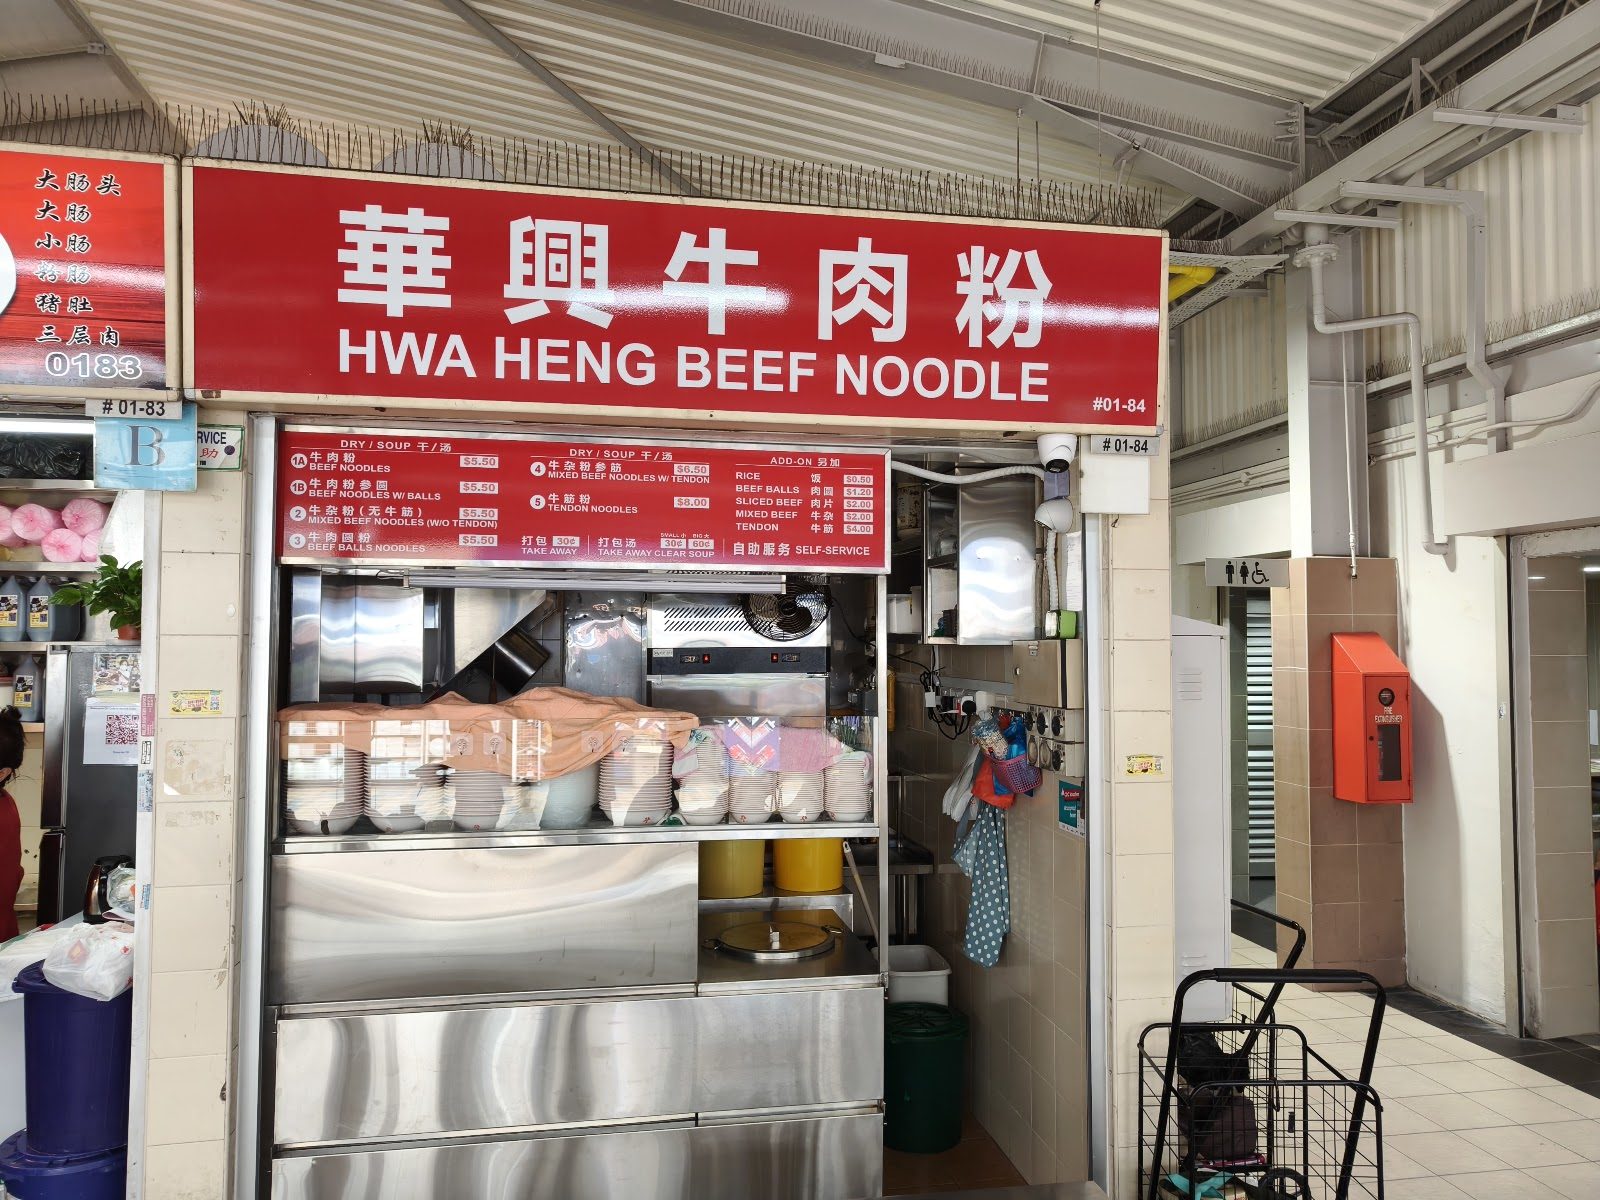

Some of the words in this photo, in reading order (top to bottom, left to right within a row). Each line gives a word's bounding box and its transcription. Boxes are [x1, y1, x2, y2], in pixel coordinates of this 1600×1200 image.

[34, 168, 121, 196] 大肠头
[35, 200, 91, 222] 大肠
[35, 233, 91, 253] 小肠
[337, 204, 1053, 349] 華興牛肉粉
[35, 293, 93, 314] 猪肚
[35, 325, 120, 347] 三层肉
[46, 352, 142, 380] 0183
[338, 328, 477, 378] HWA
[495, 336, 656, 386] HENG
[677, 345, 817, 393] BEEF
[836, 354, 1049, 402] NOODLE
[118, 399, 166, 416] 01-83
[1092, 397, 1147, 413] #01-84
[125, 425, 165, 467] B
[340, 439, 366, 448] DRY
[369, 440, 374, 448] /
[377, 441, 411, 450] SOUP
[1114, 438, 1149, 453] 01-84
[310, 451, 355, 463] 牛肉粉
[569, 448, 594, 457] DRY
[596, 449, 600, 457] /
[603, 450, 635, 458] SOUP
[293, 456, 305, 466] 1A
[463, 457, 496, 466] $5.50
[770, 457, 812, 466] ADD-ON
[817, 458, 840, 467] 另加
[309, 463, 338, 471] BEEF
[340, 464, 391, 473] NOODLES
[534, 464, 541, 474] 4
[676, 465, 707, 474] $6.50
[548, 471, 579, 479] MIXED
[581, 472, 607, 480] BEEF
[609, 473, 655, 482] NOODLES
[671, 475, 710, 484] TENDON
[736, 472, 760, 480] RICE
[811, 473, 821, 484] 饭
[846, 475, 872, 484] $0.50
[292, 482, 305, 492] 1B
[463, 483, 496, 492] $5.50
[736, 485, 763, 493] BEEF
[766, 486, 800, 494] BALLS
[846, 488, 872, 496] $1.20
[339, 490, 390, 498] NOODLES
[407, 492, 441, 501] BALLS
[548, 493, 591, 505] 牛筋粉
[534, 497, 541, 507] 5
[676, 497, 707, 507] $8.00
[776, 499, 803, 507] BEEF
[811, 499, 834, 509] 肉片
[846, 500, 872, 509] $2.00
[294, 509, 302, 519] 2
[462, 509, 495, 518] $5.50
[548, 504, 589, 512] TENDON
[591, 505, 638, 514] NOODLES
[736, 510, 768, 518] MIXED
[771, 511, 798, 519] BEEF
[811, 511, 834, 521] 牛杂
[846, 512, 872, 521] $2.00
[308, 516, 341, 524] MIXED
[344, 517, 372, 525] BEEF
[374, 518, 424, 526] NOODLES
[736, 522, 779, 531] TENDON
[811, 523, 834, 534] 牛筋
[846, 524, 872, 533] $4.00
[294, 536, 301, 545] 3
[462, 535, 495, 545] $5.50
[521, 536, 547, 546] 打包
[597, 537, 636, 548] 打包汤
[308, 543, 336, 551] BEEF
[375, 544, 426, 553] NOODLES
[521, 547, 547, 555] TAKE
[549, 547, 577, 555] AWAY
[598, 548, 623, 556] TAKE
[688, 550, 715, 558] SOUP
[733, 542, 791, 556] 自助服务
[795, 545, 871, 556] SELF-SERVICE
